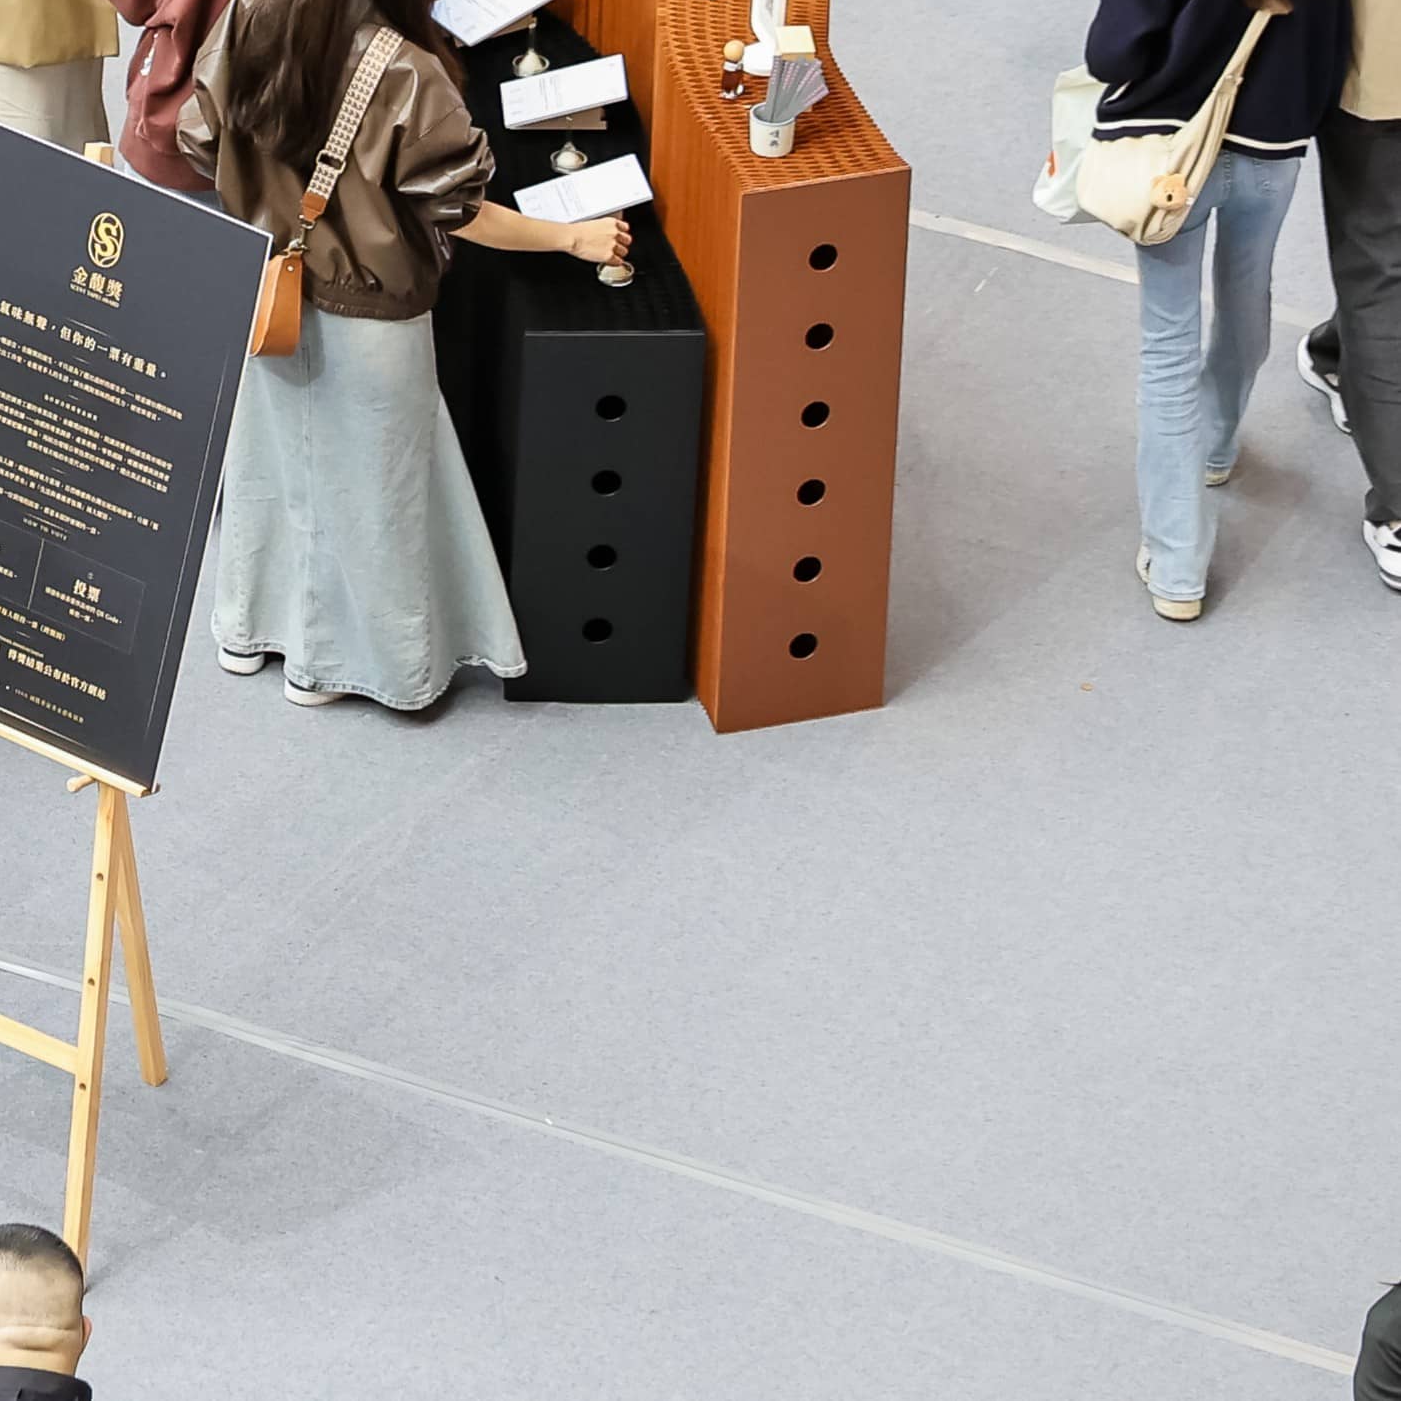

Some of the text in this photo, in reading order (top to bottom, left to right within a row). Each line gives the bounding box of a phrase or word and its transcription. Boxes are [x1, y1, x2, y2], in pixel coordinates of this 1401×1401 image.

[71, 266, 123, 302] 金馥獎
[73, 578, 101, 603] 投票
